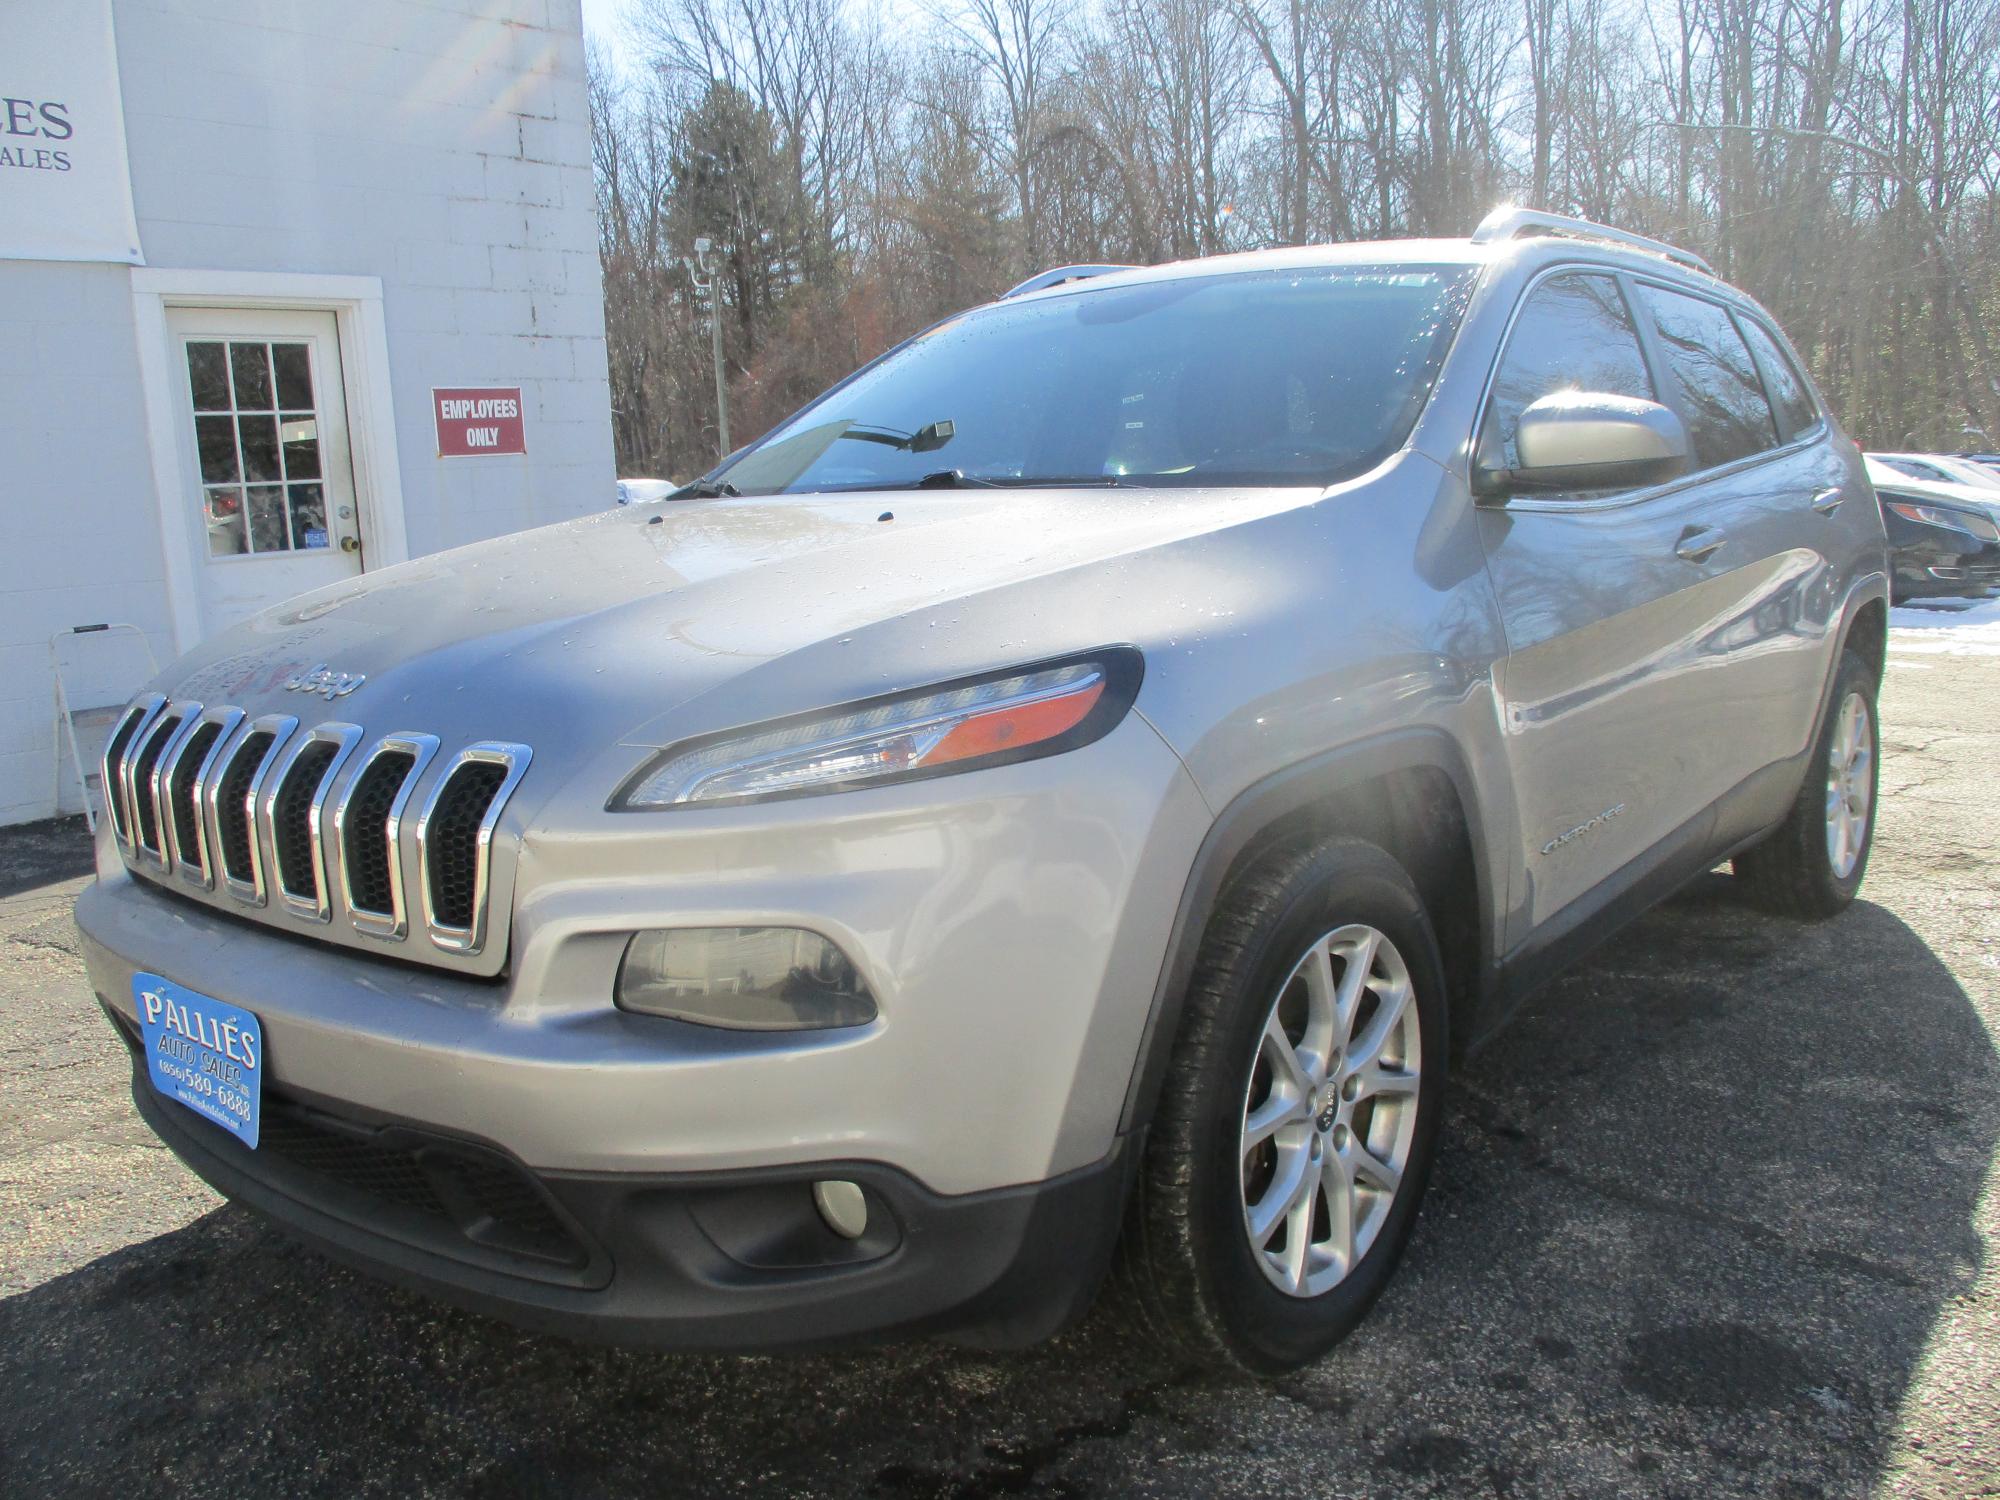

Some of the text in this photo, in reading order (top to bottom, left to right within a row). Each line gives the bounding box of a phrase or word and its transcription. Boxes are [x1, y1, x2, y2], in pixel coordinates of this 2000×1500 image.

[0, 98, 74, 140] ES
[441, 399, 518, 419] EMPLOYEES
[466, 427, 499, 447] ONLY
[284, 663, 366, 701] Jeep
[158, 1033, 242, 1089] AUTO SALES
